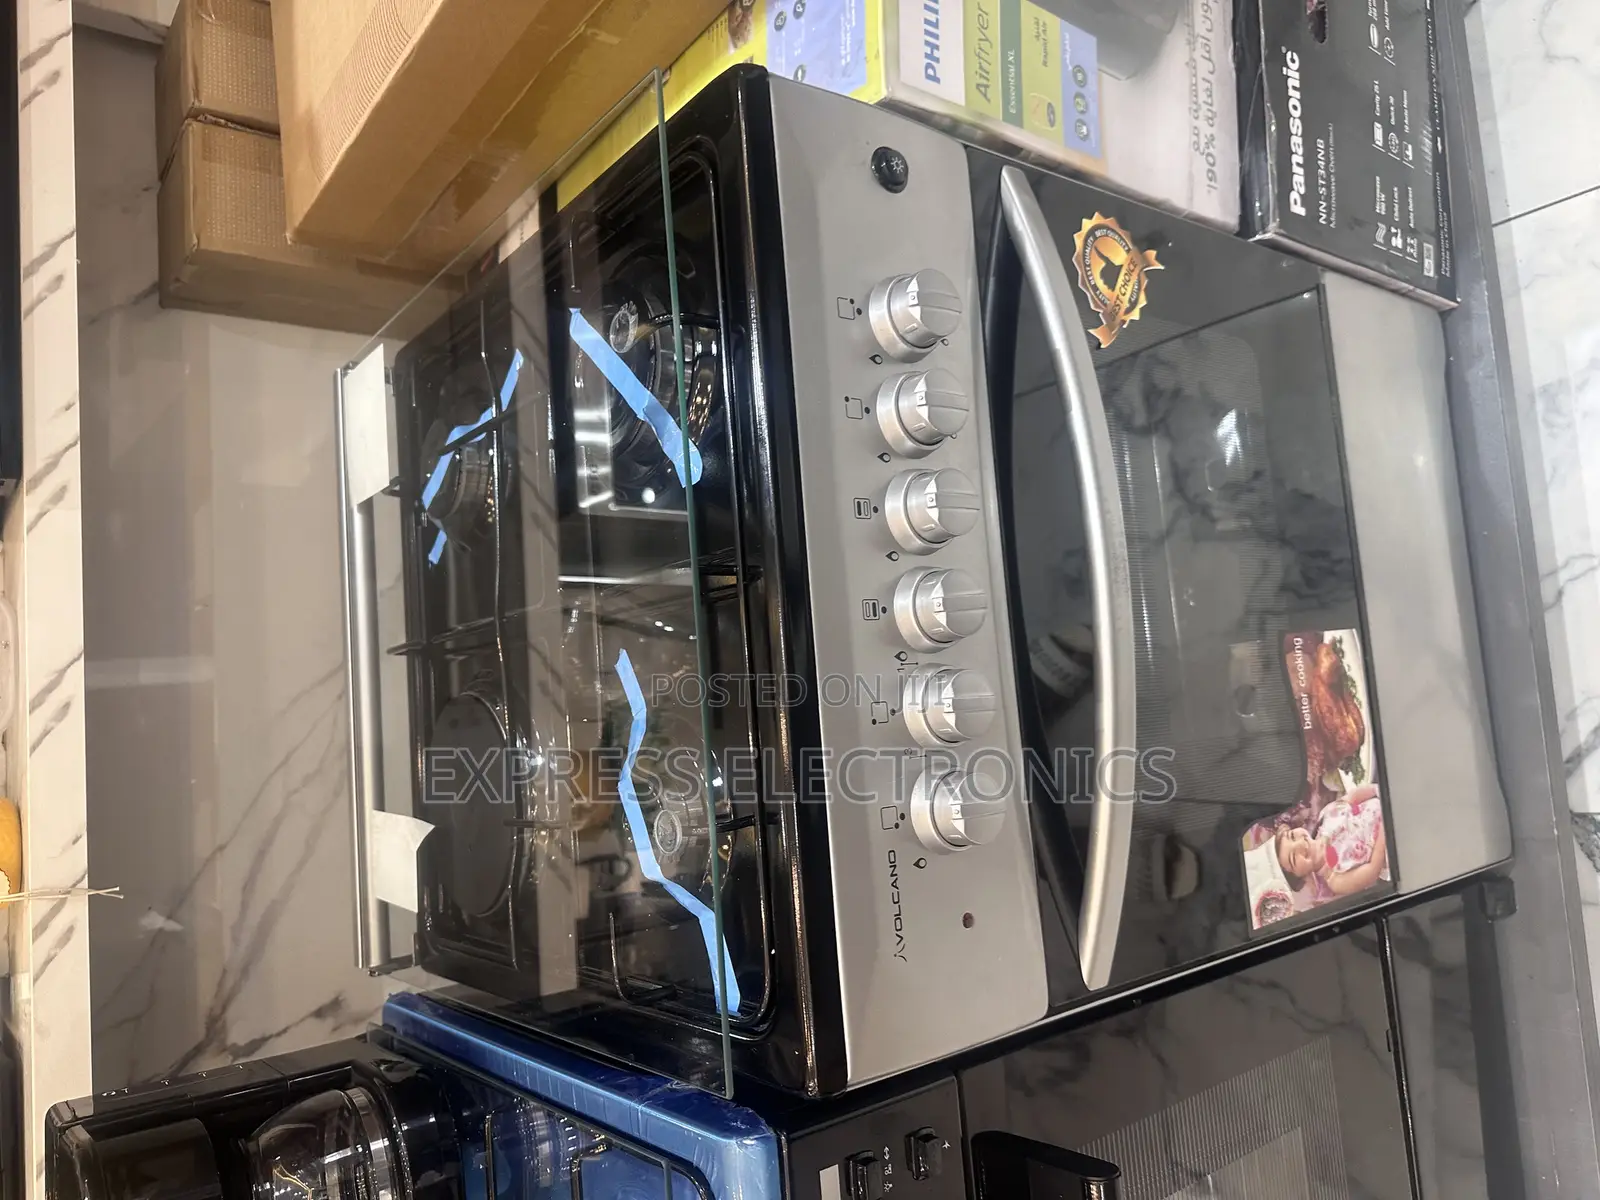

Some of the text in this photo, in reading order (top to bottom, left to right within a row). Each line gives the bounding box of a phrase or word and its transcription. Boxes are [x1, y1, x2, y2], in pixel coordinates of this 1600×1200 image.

[923, 0, 941, 85] PHILI
[973, 1, 993, 104] Airfryer
[1007, 48, 1017, 114] Essential XL
[1282, 51, 1306, 217] Panasonic
[1316, 138, 1327, 226] NN-ST34NB
[1329, 175, 1337, 229] Microwave
[1109, 257, 1138, 322] BEST CHOICE
[1293, 637, 1312, 730] better cooking
[888, 849, 903, 946] VOLCANO
